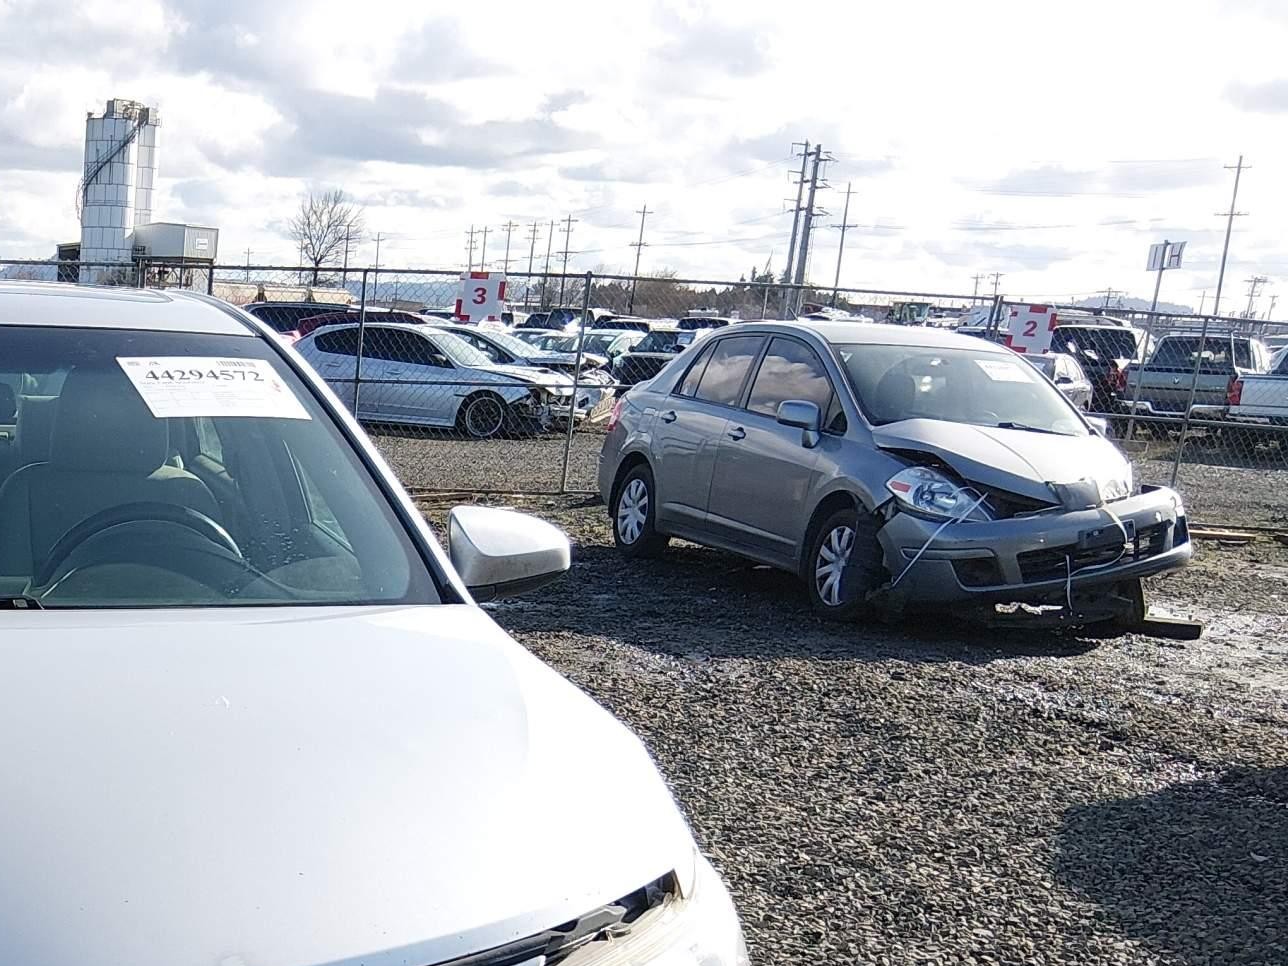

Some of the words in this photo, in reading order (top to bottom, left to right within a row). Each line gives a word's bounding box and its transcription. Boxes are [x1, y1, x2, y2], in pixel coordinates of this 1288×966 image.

[1169, 244, 1183, 267] H
[472, 287, 487, 305] 3
[1022, 320, 1038, 337] 2
[145, 369, 265, 382] 44294572
